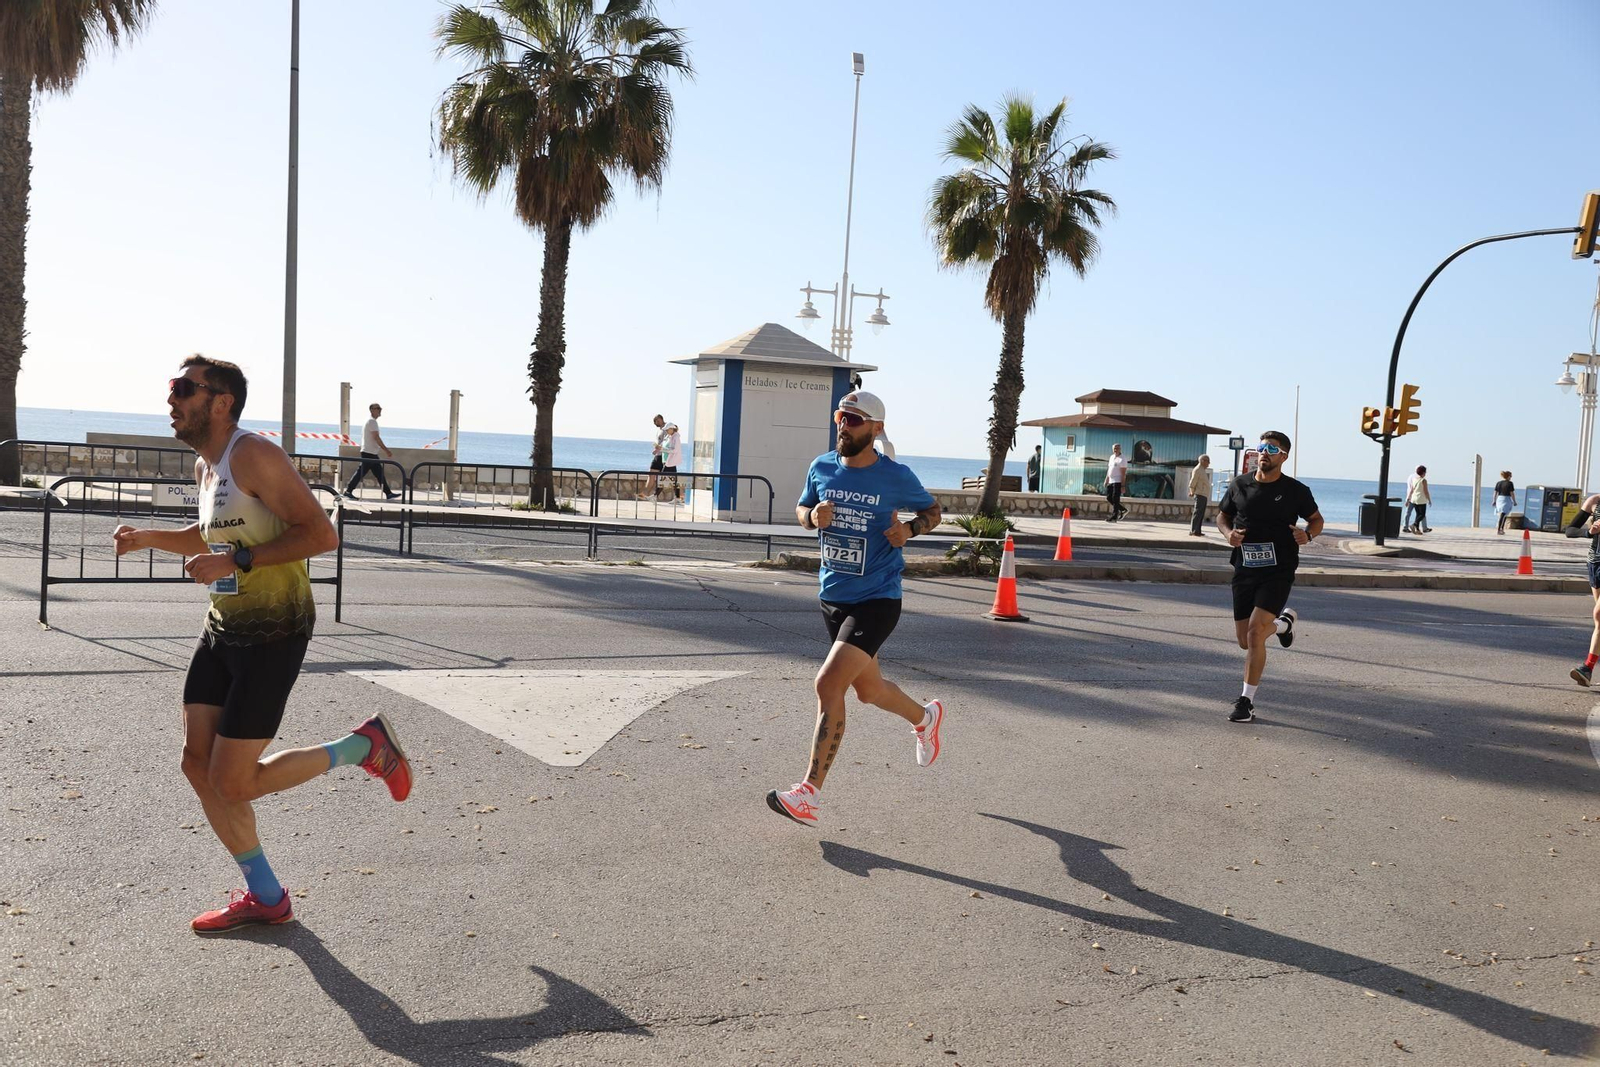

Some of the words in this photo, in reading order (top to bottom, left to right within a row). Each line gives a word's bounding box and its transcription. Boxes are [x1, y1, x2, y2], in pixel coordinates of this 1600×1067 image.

[745, 376, 778, 387] Helados
[785, 379, 798, 389] Ice
[800, 380, 830, 391] Creams
[825, 488, 880, 506] mayoral
[832, 514, 868, 524] AKES
[831, 521, 868, 532] RIENDS
[825, 546, 858, 562] 1721
[1245, 551, 1271, 560] 1828
